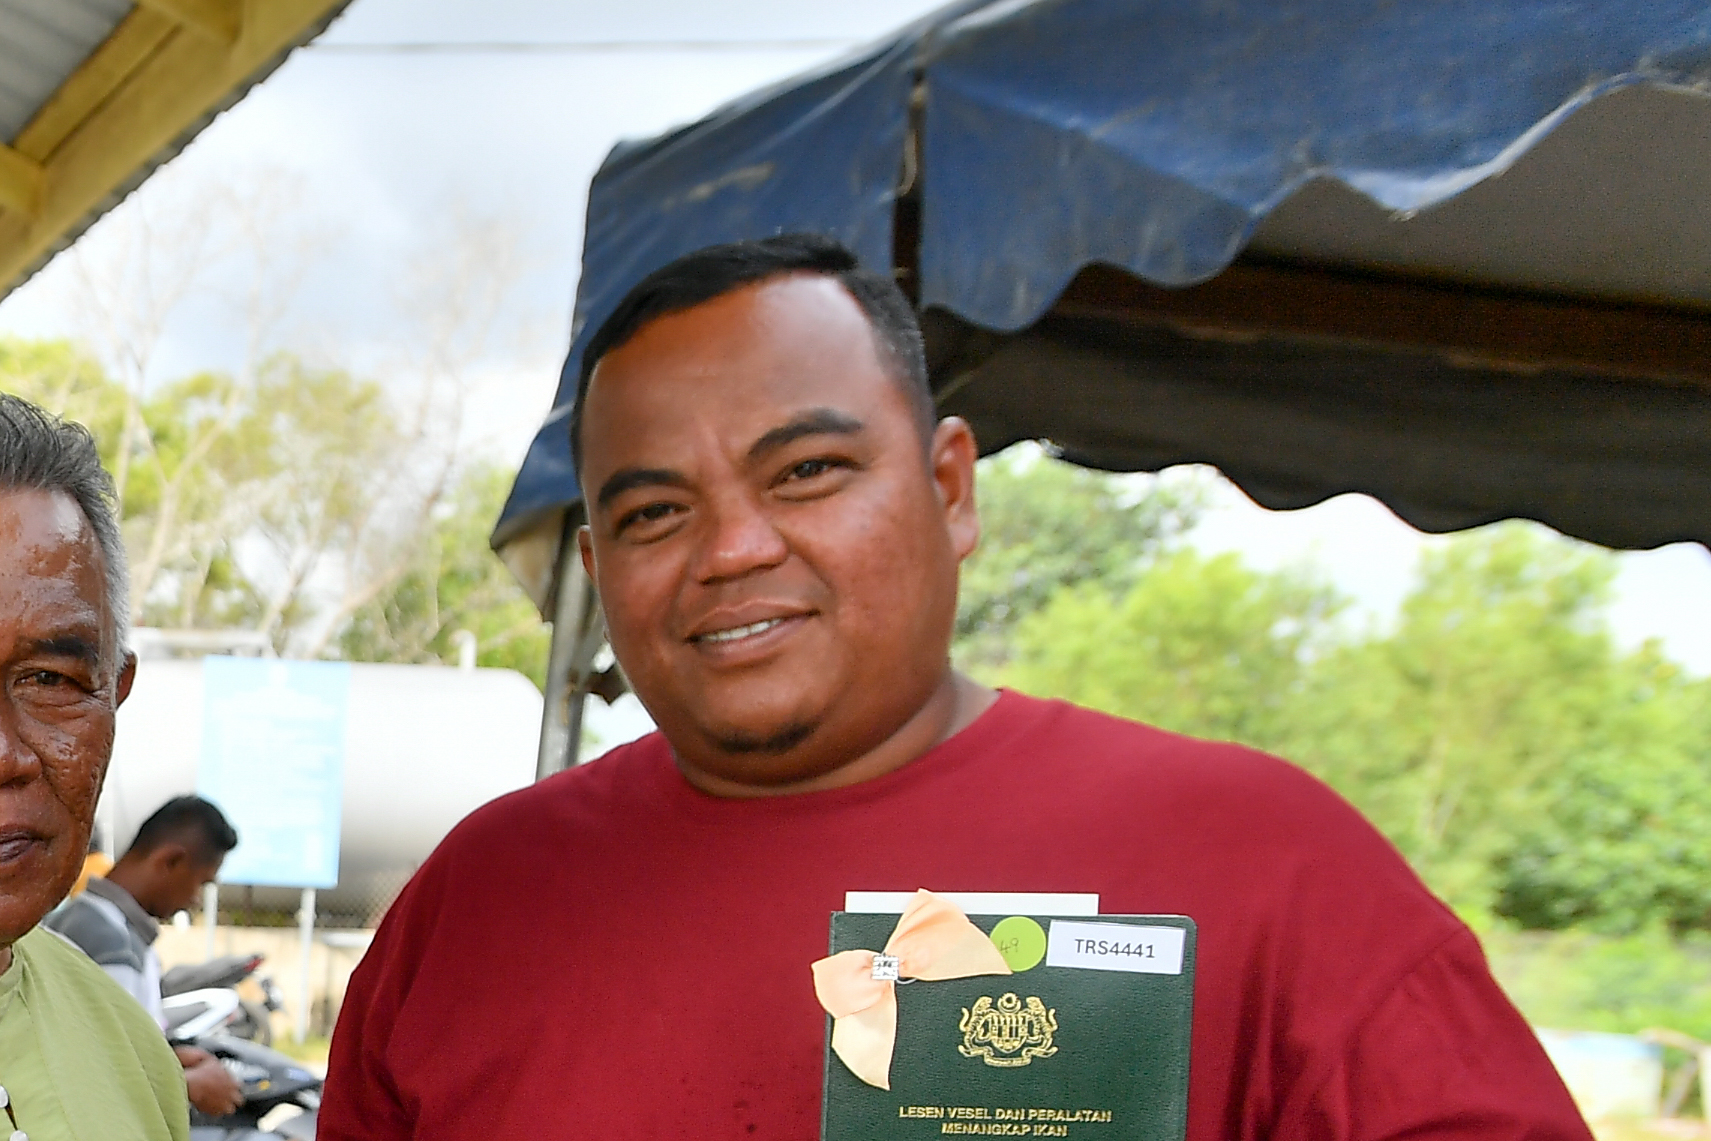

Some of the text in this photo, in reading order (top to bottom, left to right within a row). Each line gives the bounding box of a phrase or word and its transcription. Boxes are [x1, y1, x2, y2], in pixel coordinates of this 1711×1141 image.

[1075, 938, 1155, 959] TRS4441
[898, 1106, 1112, 1123] LESEN VESEL DAN PERALATAN
[941, 1122, 1068, 1137] MENANGKAP IKAN
